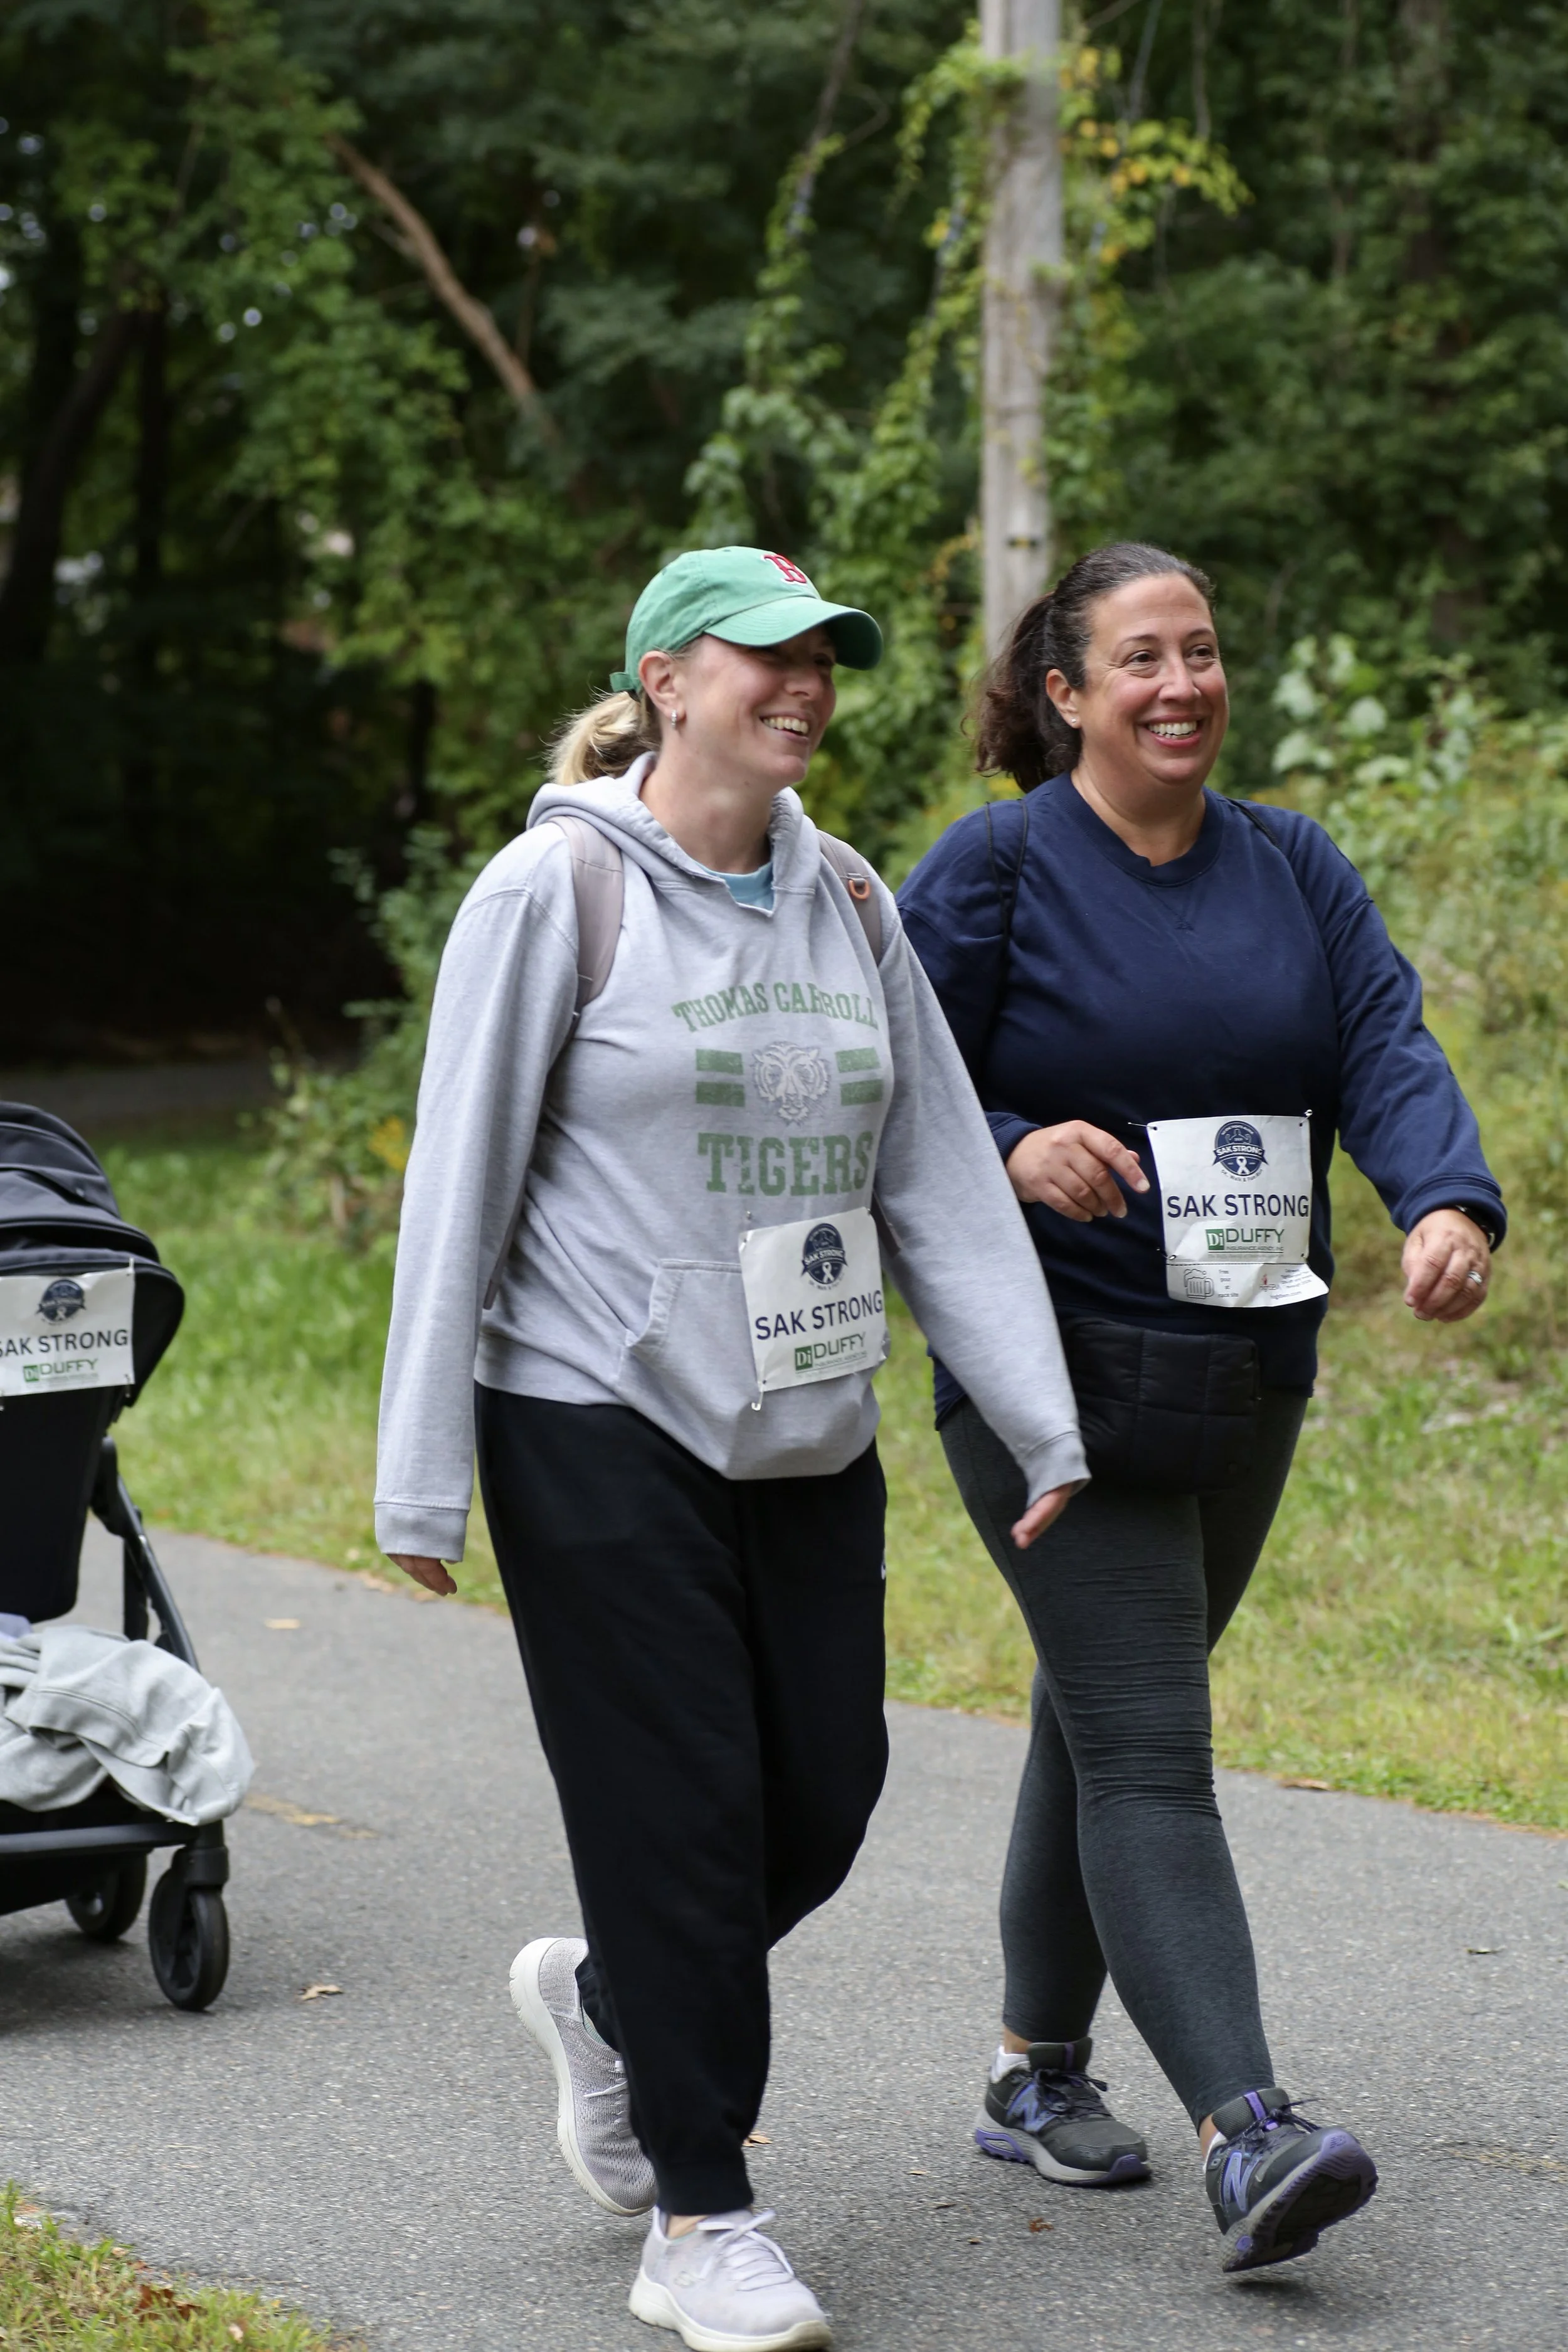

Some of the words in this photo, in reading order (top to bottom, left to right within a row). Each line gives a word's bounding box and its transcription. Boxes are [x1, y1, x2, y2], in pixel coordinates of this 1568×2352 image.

[671, 982, 769, 1032] THOMAS
[773, 982, 878, 1030] CARROLL
[697, 1131, 873, 1196] TIGERS
[1167, 1195, 1218, 1218] SAK
[1224, 1194, 1310, 1217] STRONG
[1207, 1233, 1224, 1246] Di
[1226, 1228, 1285, 1243] DUFFY
[755, 1310, 807, 1340] SAK
[812, 1290, 882, 1330] STRONG
[38, 1330, 128, 1353] STRONG
[796, 1350, 812, 1367] Di
[813, 1332, 866, 1359] DUFFY
[40, 1359, 98, 1375] DUFFY
